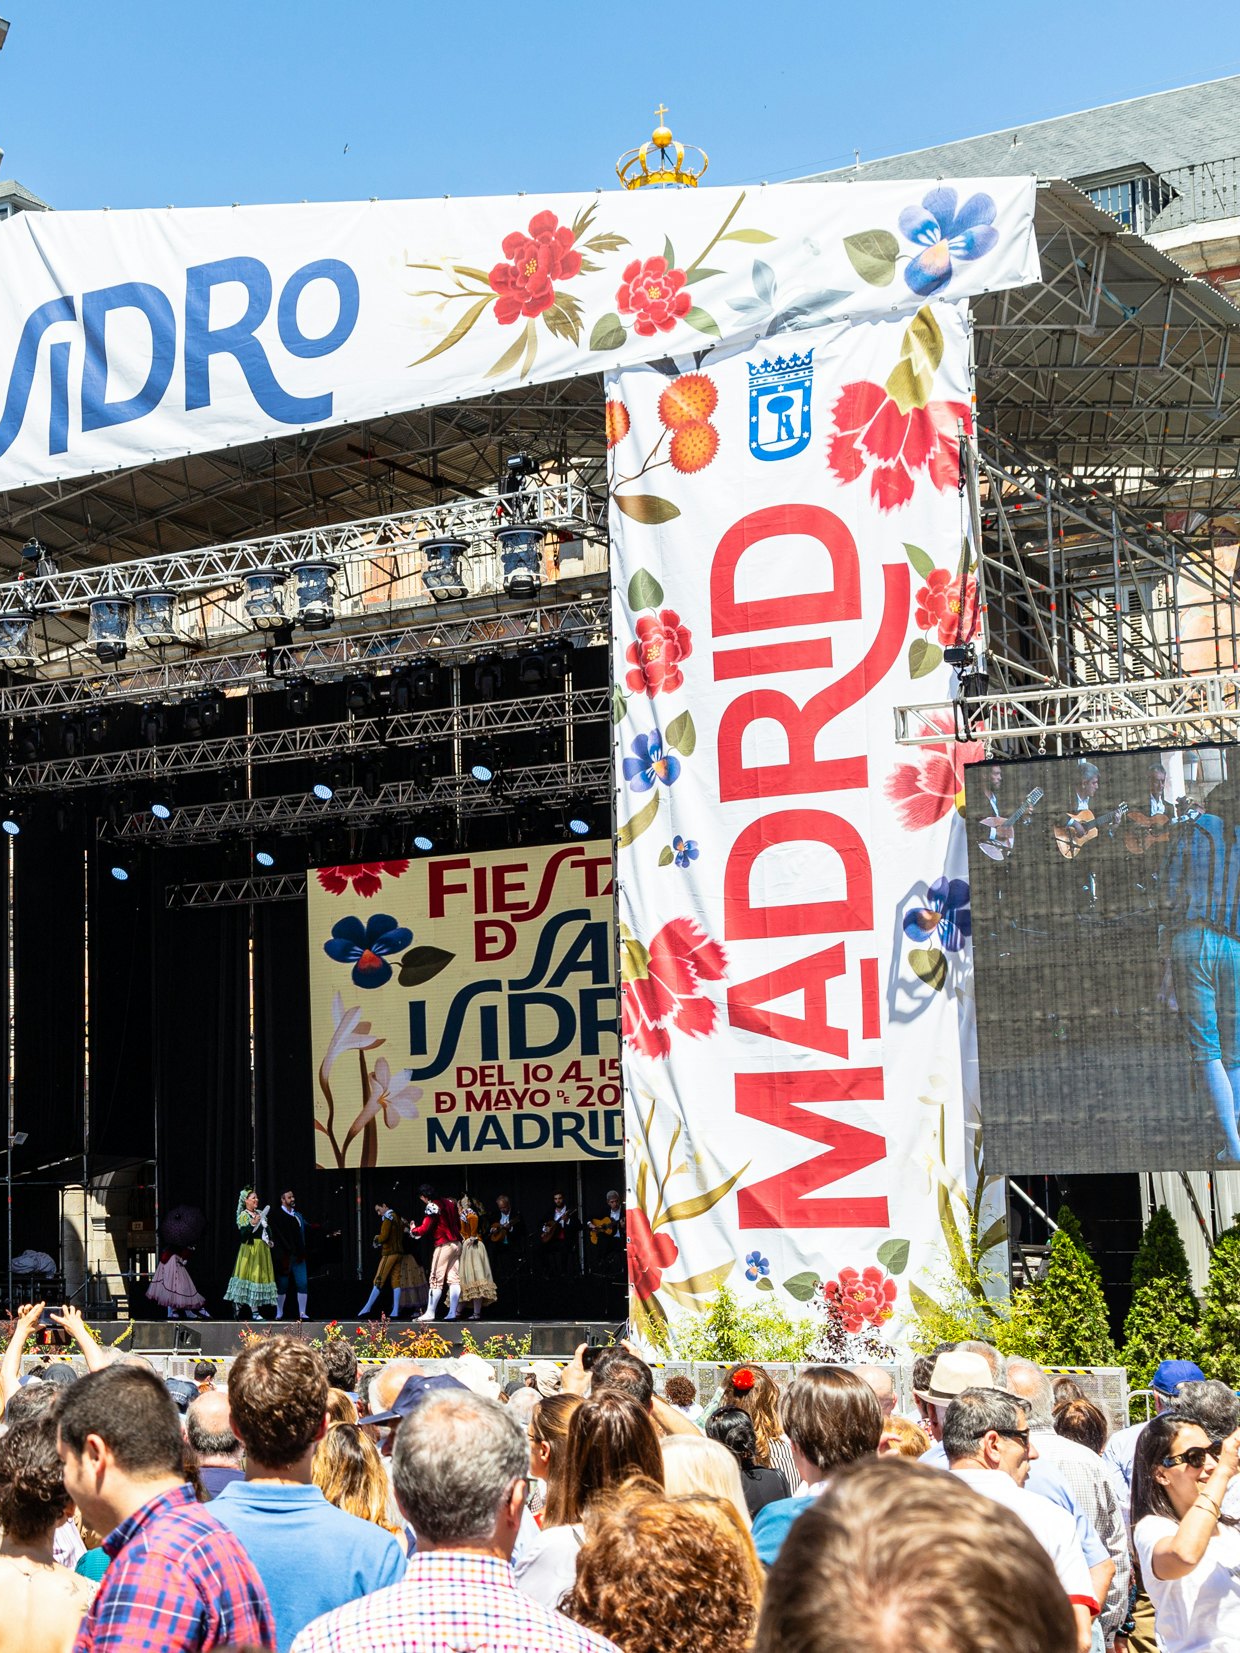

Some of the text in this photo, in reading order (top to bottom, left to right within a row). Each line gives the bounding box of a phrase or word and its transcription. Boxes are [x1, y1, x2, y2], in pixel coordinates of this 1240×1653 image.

[709, 503, 915, 1231] MADRID
[507, 908, 610, 991] SA
[404, 979, 619, 1081] ISIDR
[456, 1064, 515, 1088] DEL
[558, 1060, 593, 1084] AL
[465, 1087, 551, 1113] MAYO
[556, 1089, 571, 1105] DE
[575, 1083, 621, 1107] 20
